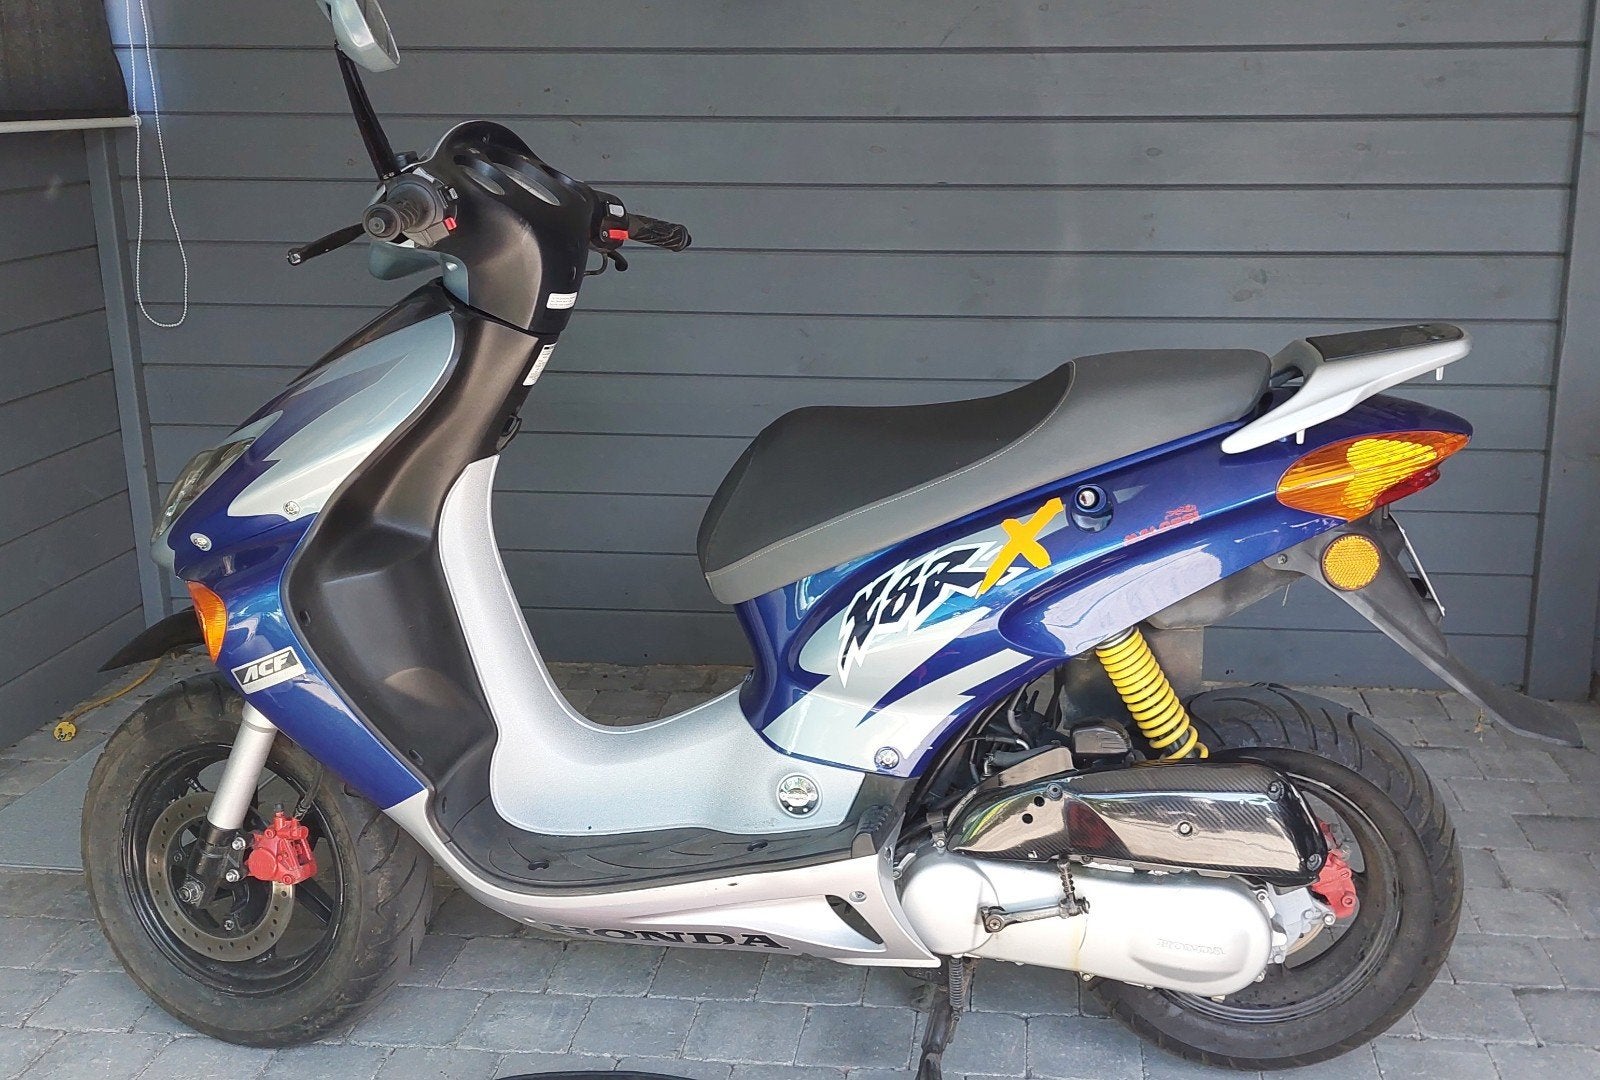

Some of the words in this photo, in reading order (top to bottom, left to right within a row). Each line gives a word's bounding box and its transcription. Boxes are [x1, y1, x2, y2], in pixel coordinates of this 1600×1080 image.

[243, 651, 290, 684] ACF
[543, 922, 791, 950] HONDA
[1156, 938, 1226, 956] HONDA
